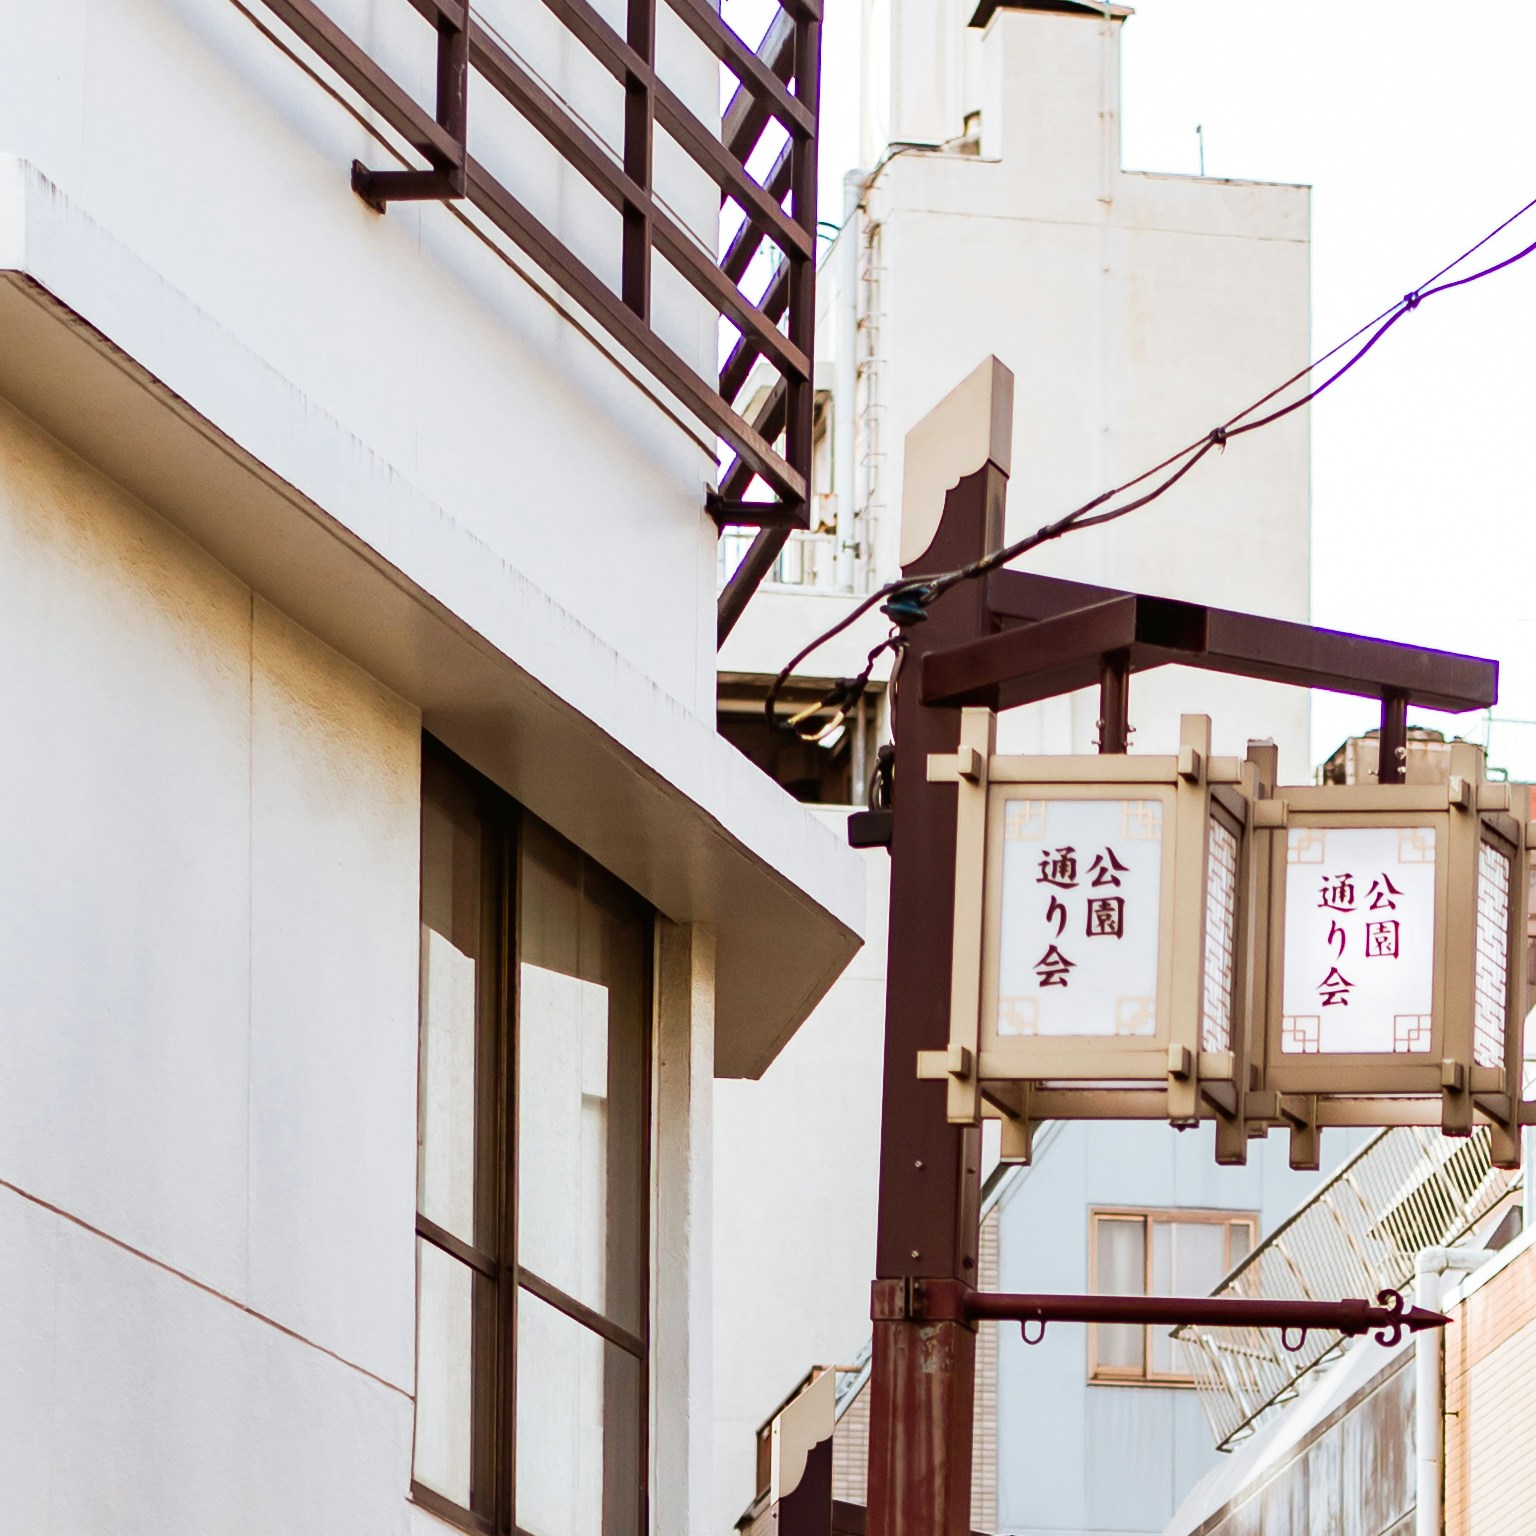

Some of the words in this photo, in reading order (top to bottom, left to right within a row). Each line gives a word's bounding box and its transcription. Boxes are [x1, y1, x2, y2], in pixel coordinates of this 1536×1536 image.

[1032, 847, 1078, 989] 通り会
[1084, 845, 1131, 940] 公園
[1316, 873, 1358, 1008] 通り会
[1363, 871, 1406, 960] 公園
